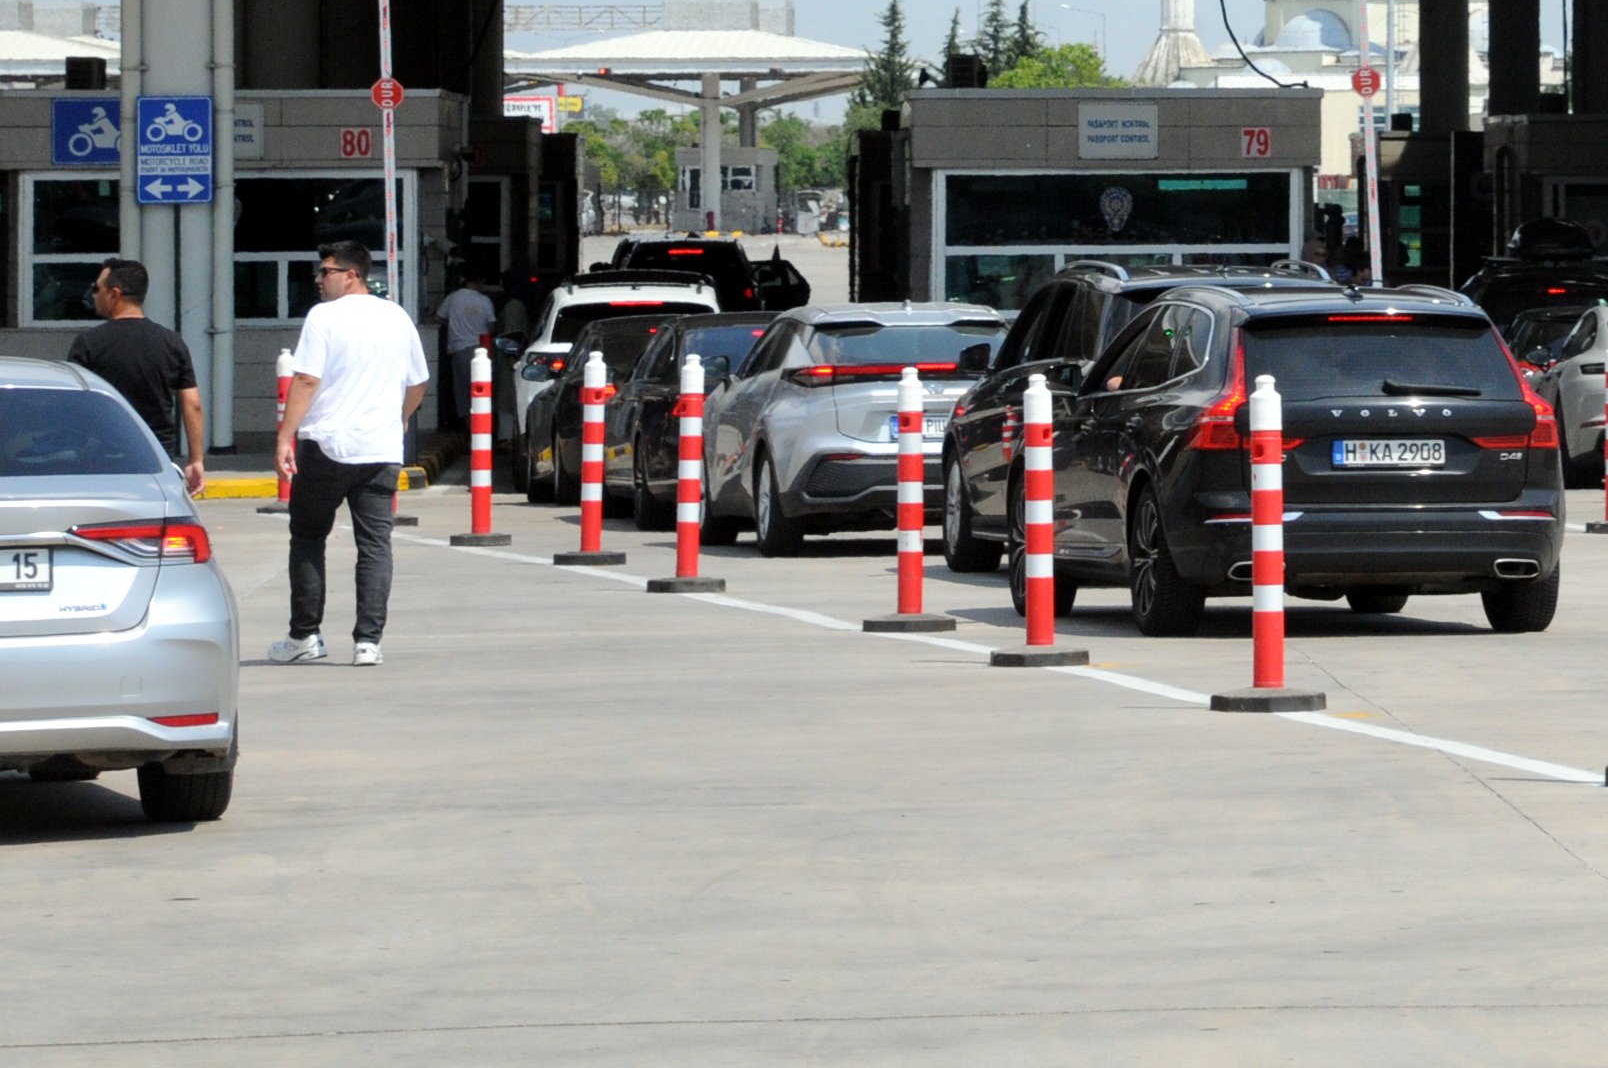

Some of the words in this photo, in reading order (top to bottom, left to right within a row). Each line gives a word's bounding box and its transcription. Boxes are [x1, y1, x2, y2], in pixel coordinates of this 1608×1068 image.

[381, 81, 394, 108] DUR
[1360, 69, 1372, 95] DUR
[342, 129, 372, 157] 80
[1243, 129, 1269, 156] 79
[1330, 408, 1452, 418] VOLVO
[1345, 442, 1357, 462] H
[1397, 442, 1443, 462] 2908
[12, 552, 38, 580] 15
